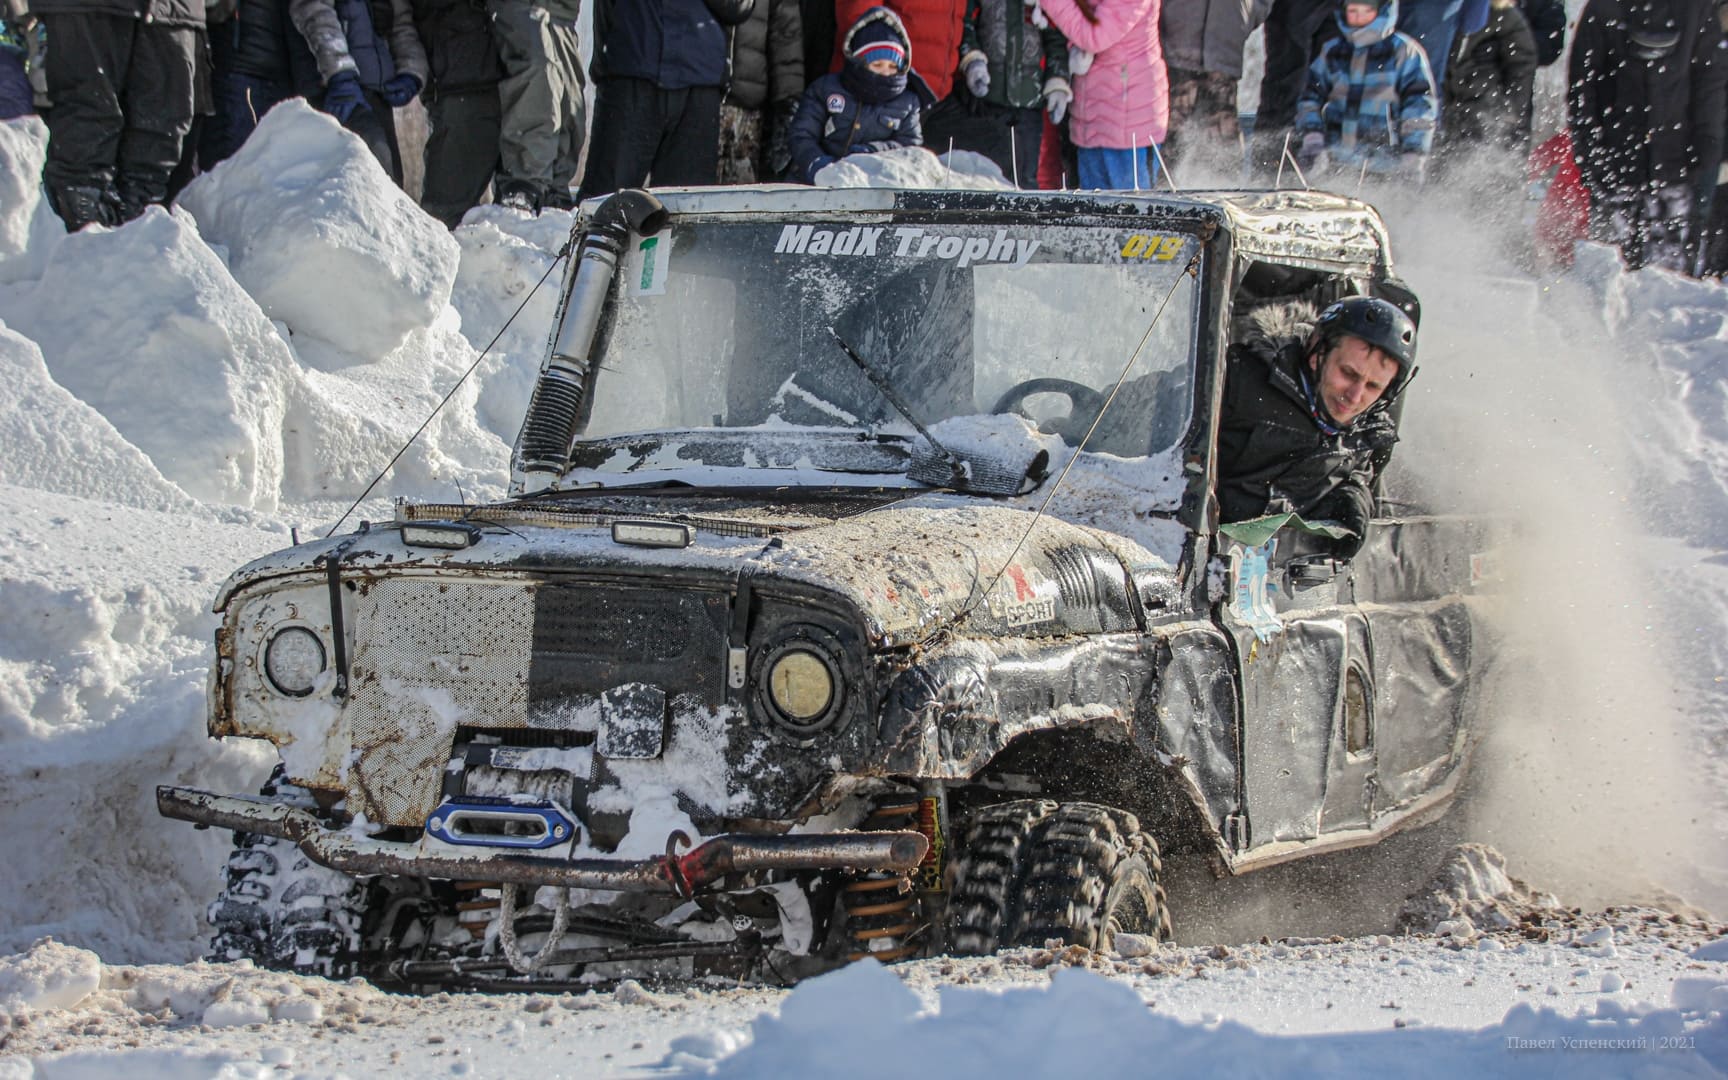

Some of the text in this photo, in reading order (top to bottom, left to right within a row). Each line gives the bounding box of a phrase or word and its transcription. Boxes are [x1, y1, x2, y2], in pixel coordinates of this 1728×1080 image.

[639, 236, 659, 290] 1
[774, 225, 1041, 271] MadX Trophy
[1120, 234, 1185, 260] 019
[1006, 599, 1053, 623] SPORT
